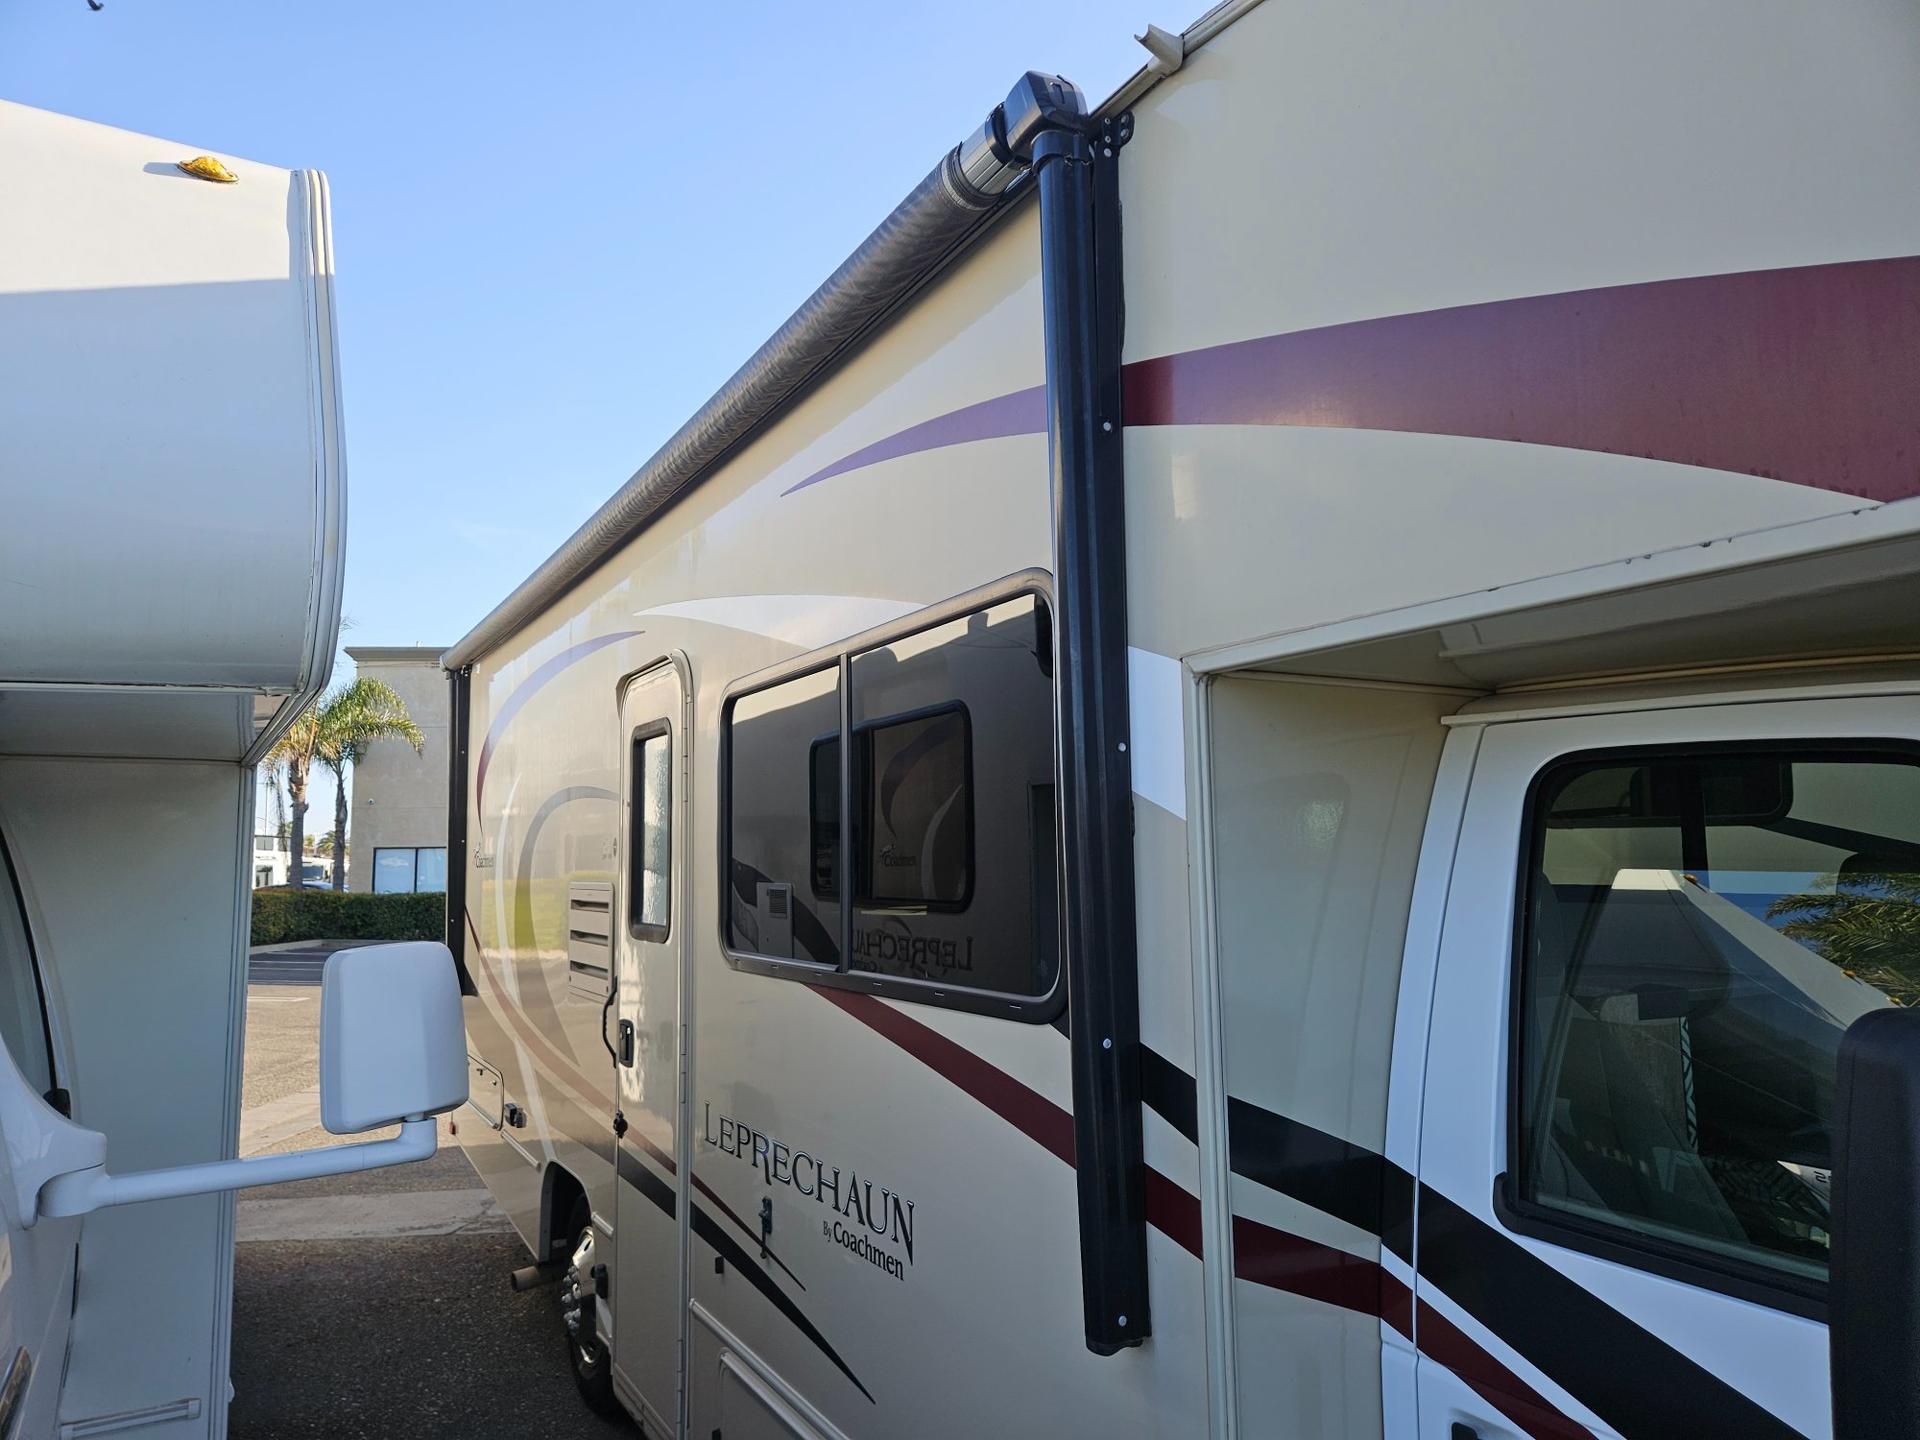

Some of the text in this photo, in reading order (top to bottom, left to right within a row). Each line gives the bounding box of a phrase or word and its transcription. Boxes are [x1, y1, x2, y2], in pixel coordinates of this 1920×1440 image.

[704, 1100, 915, 1266] LEPRECHAUN
[823, 1220, 905, 1282] By Coachmen
